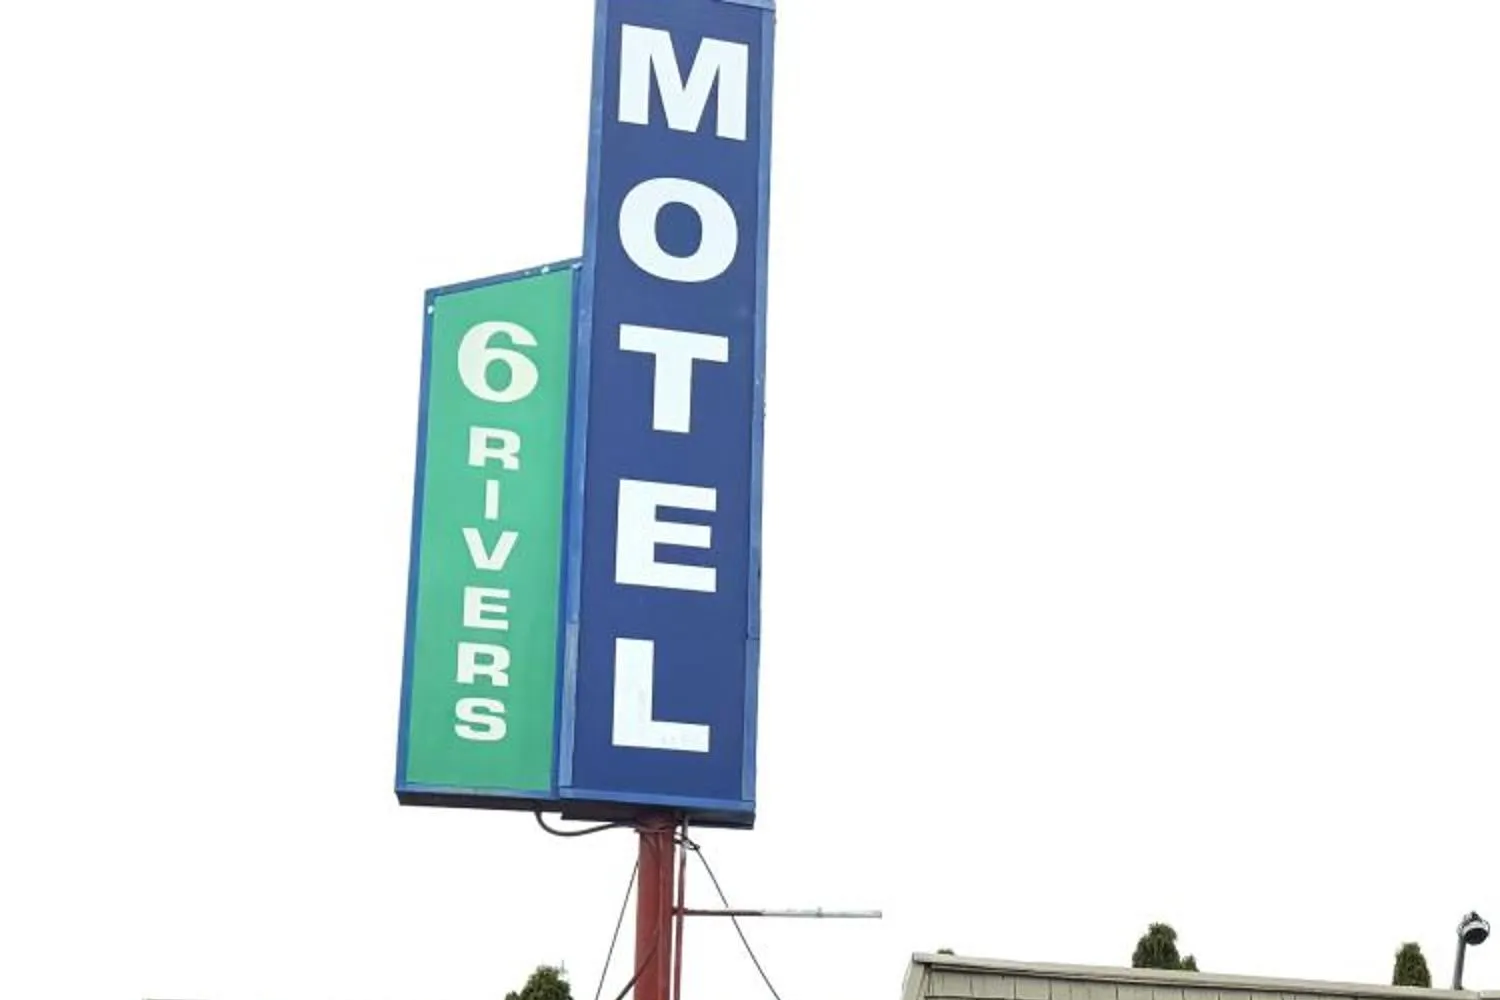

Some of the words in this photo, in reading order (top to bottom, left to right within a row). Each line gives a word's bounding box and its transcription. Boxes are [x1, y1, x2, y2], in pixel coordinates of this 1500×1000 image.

[457, 320, 540, 403] 6
[612, 23, 749, 753] MOTEL
[453, 426, 522, 742] RIVERS
